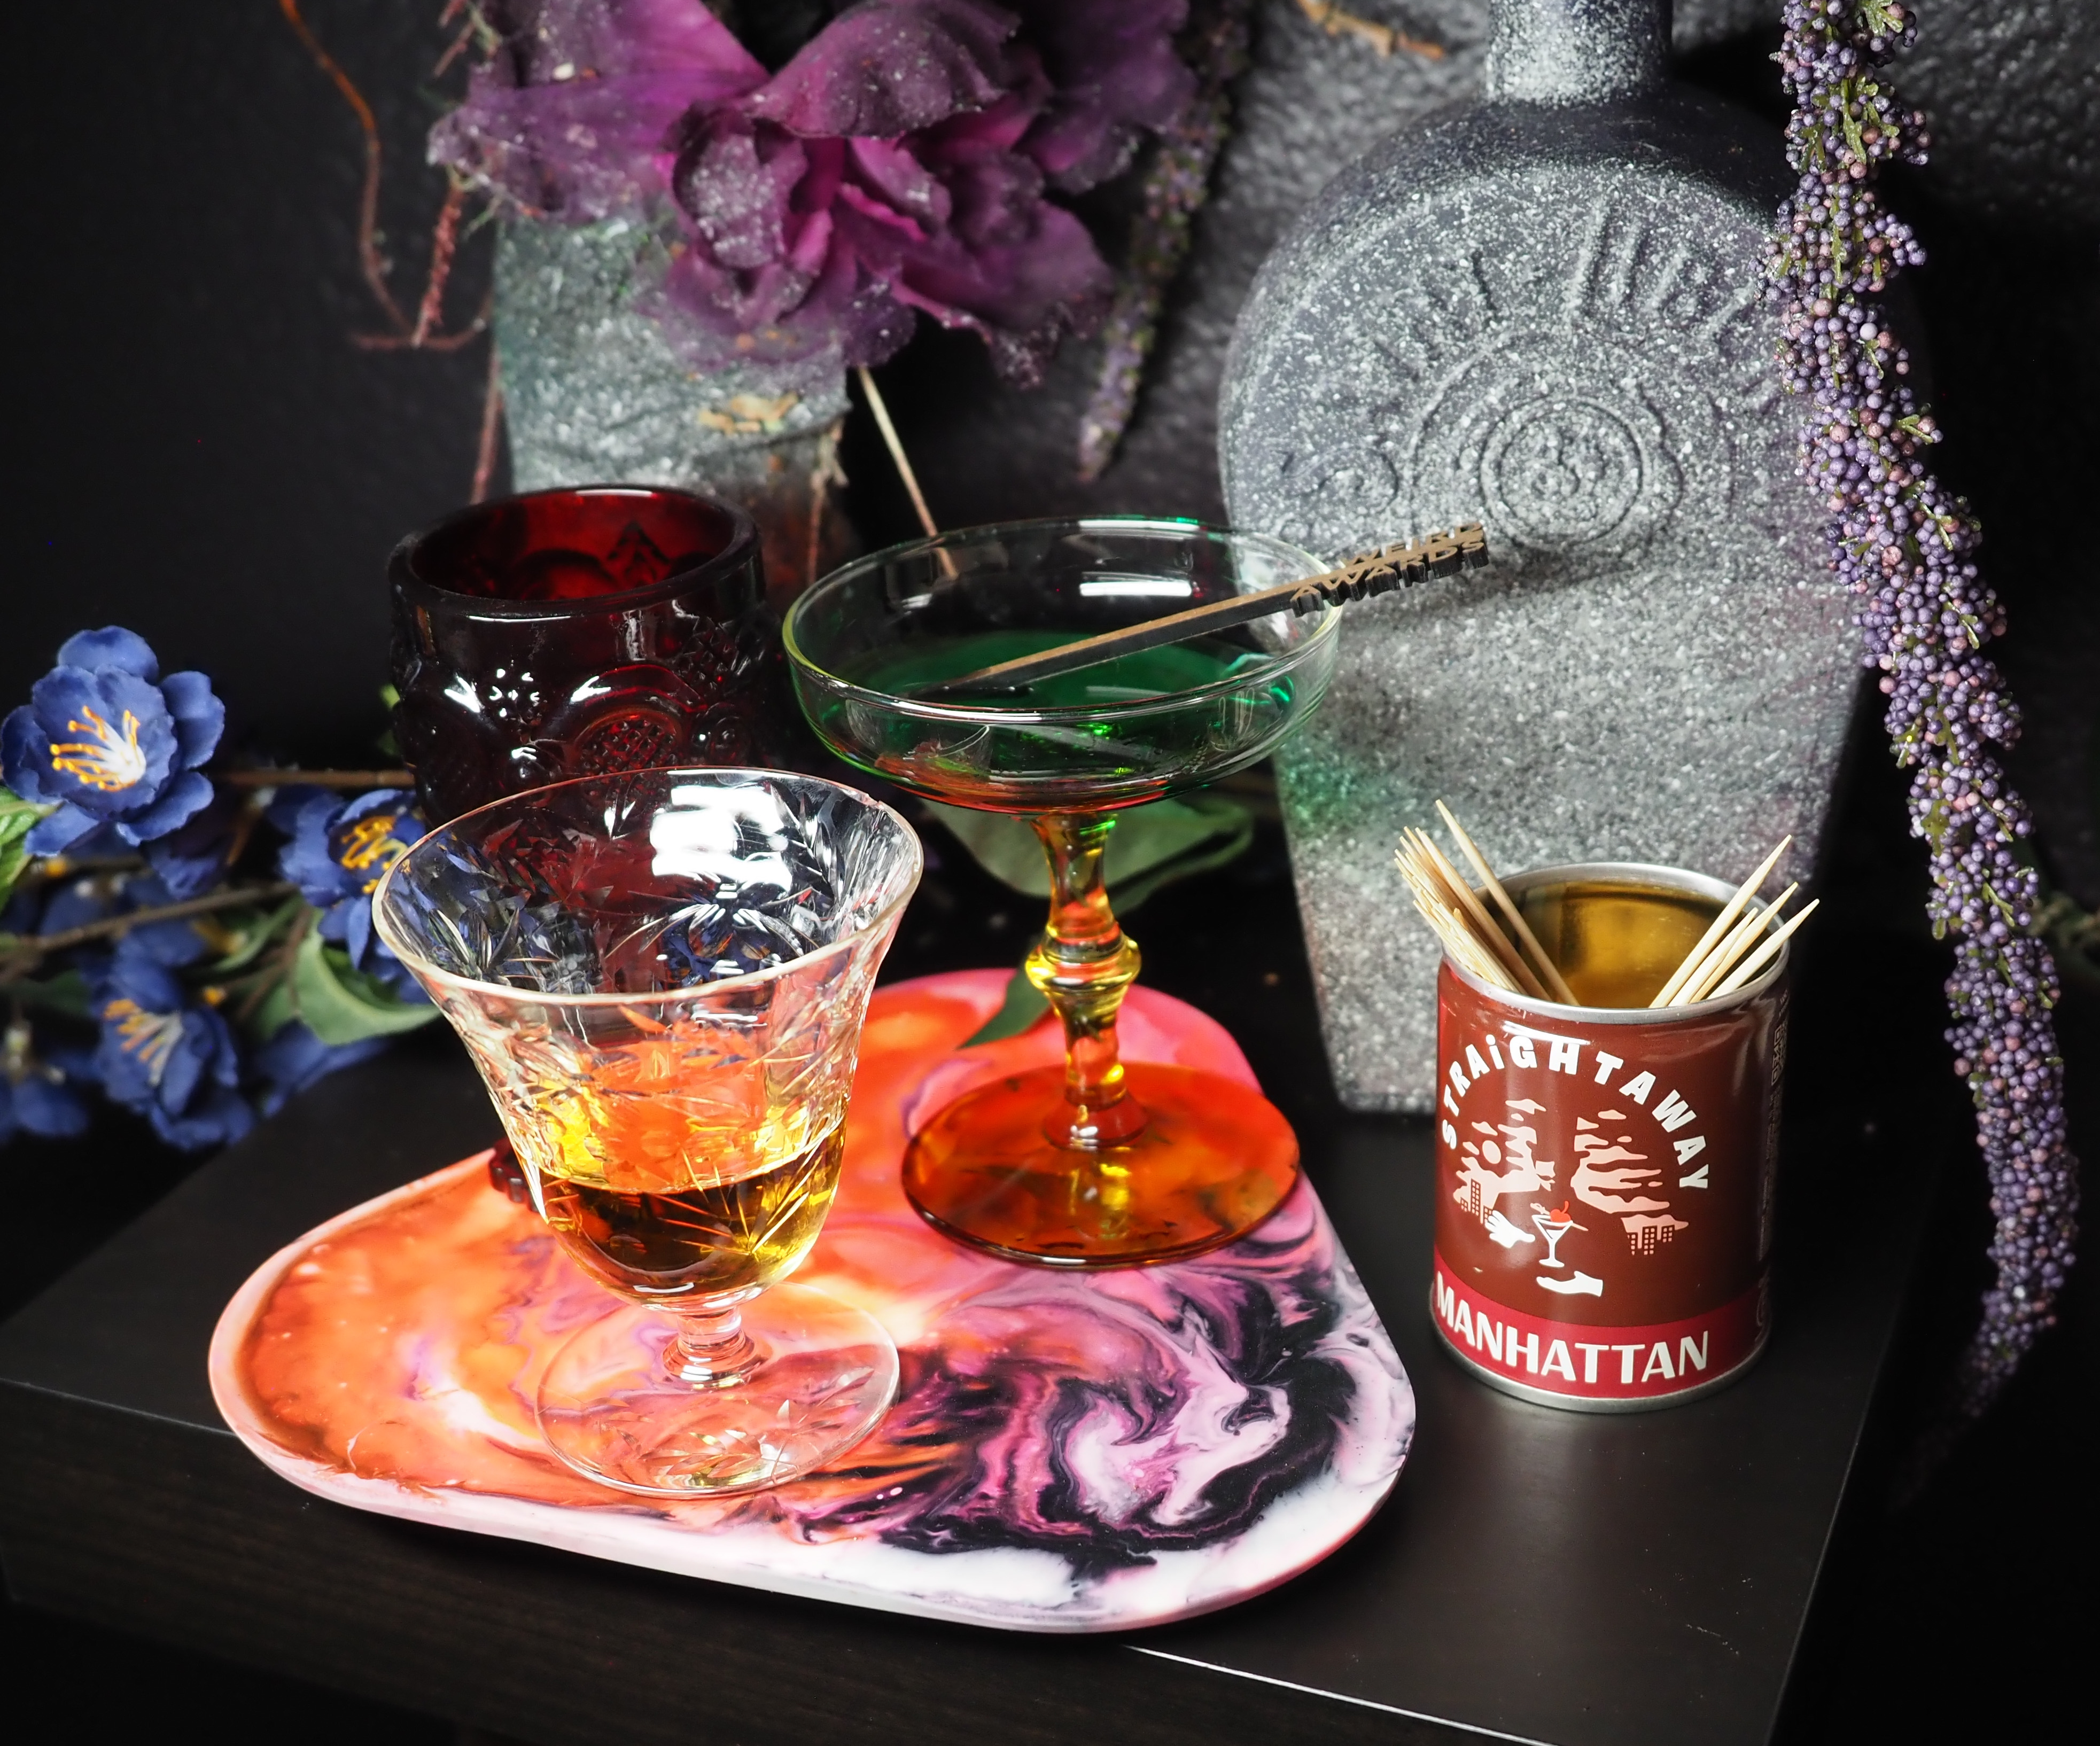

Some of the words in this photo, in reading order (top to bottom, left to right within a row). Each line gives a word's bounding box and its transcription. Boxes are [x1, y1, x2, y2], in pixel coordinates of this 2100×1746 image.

[1290, 541, 1488, 617] AWARDS
[1342, 522, 1483, 565] WEIRD
[1437, 1271, 1708, 1383] MANHATTAN
